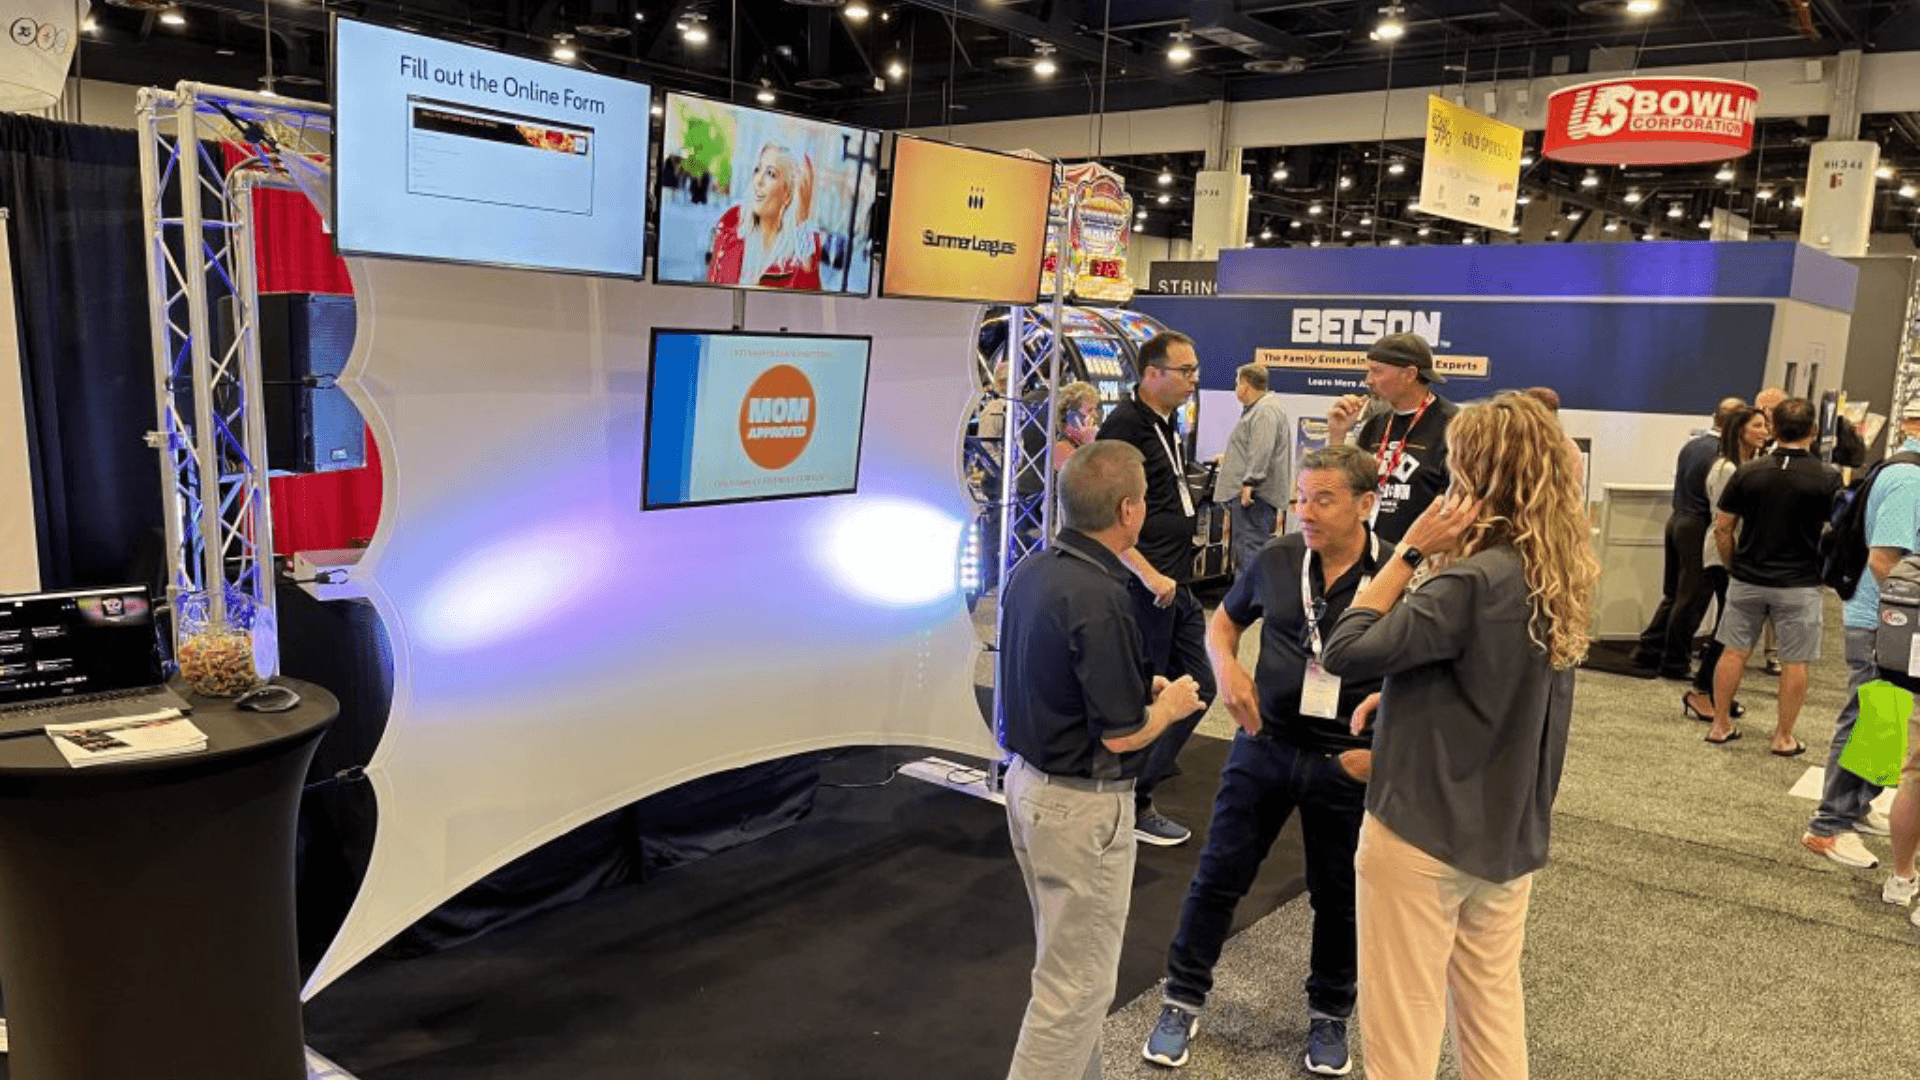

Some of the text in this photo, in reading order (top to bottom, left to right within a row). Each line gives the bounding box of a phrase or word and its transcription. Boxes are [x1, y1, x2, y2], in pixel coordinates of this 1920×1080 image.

[401, 54, 605, 115] Fill out the Online Form
[1157, 278, 1218, 296] STRIN
[1290, 307, 1442, 348] BETSON
[1264, 353, 1282, 363] The
[1283, 354, 1317, 366] Family
[1435, 359, 1479, 371] Experts
[1308, 376, 1333, 387] Learn
[1334, 379, 1358, 389] More
[748, 397, 811, 424] MOM
[747, 425, 807, 440] APPROVED
